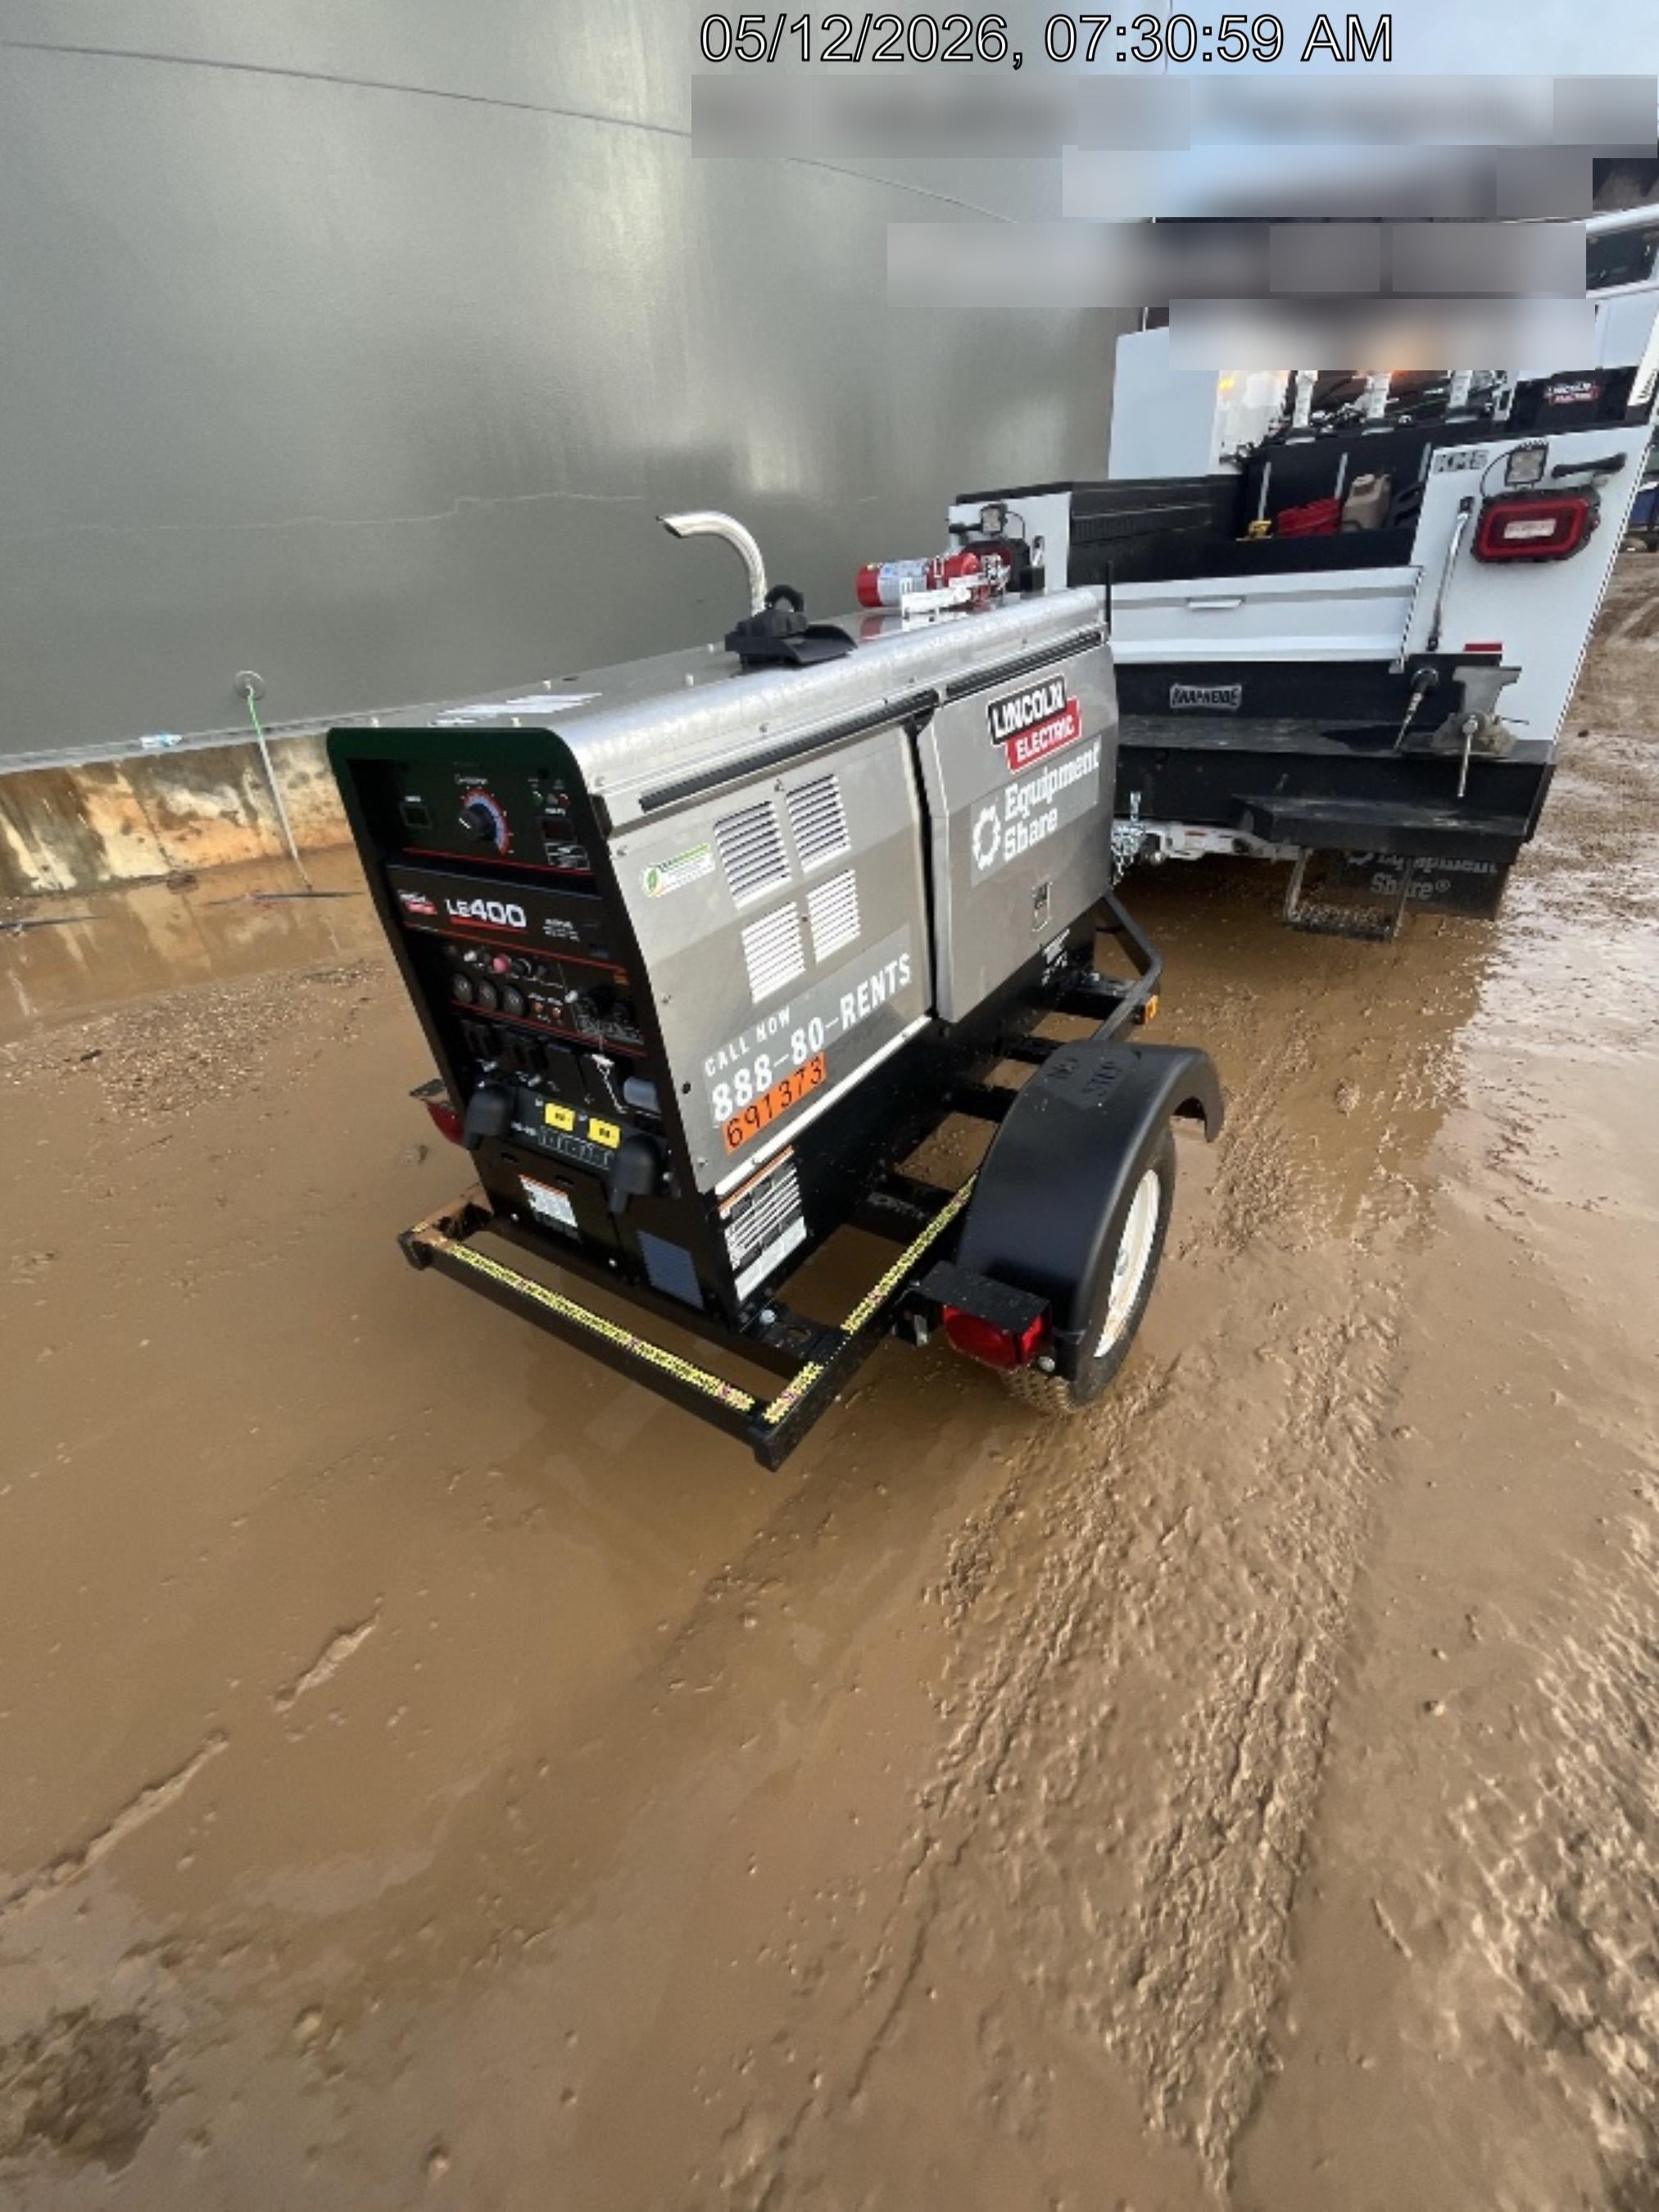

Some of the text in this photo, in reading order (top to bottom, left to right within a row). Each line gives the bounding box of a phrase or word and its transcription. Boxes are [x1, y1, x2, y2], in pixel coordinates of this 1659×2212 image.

[992, 681, 1064, 737] LINCOLN
[1016, 715, 1075, 762] ELECTRIC
[1004, 735, 1102, 821] Equipment
[1003, 807, 1058, 862] Share
[445, 899, 528, 927] LE400
[705, 1006, 791, 1077] CALL NOW
[712, 953, 911, 1122] 888-80-RENTS
[727, 1057, 822, 1148] 691373
